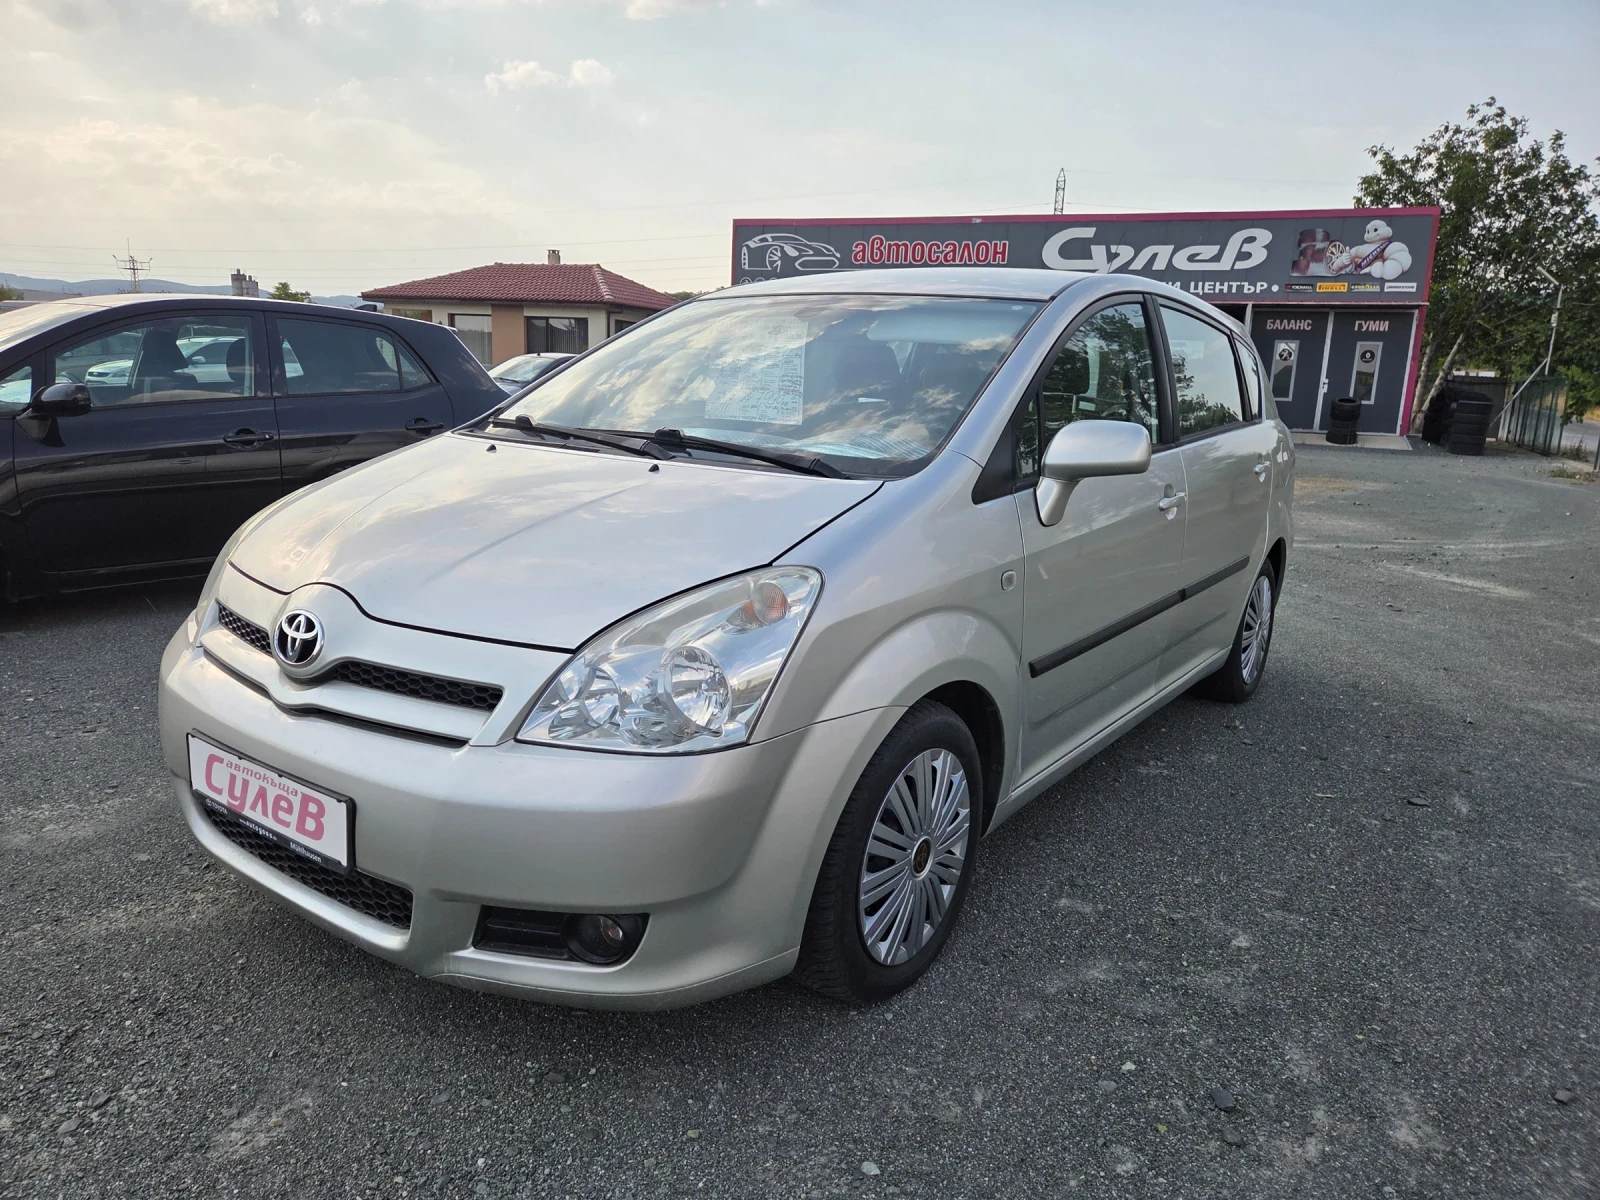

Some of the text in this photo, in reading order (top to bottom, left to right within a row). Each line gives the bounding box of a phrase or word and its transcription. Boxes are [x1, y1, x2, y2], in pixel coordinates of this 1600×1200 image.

[852, 234, 1009, 265] автосалон
[1189, 281, 1268, 295] ЦЕНТЪР
[1266, 319, 1313, 331] БАЛАНС
[1354, 320, 1390, 332] ГУМИ
[226, 760, 298, 797] автокъща
[211, 801, 228, 815] TOYOTA
[290, 841, 322, 864] Mühlhausen
